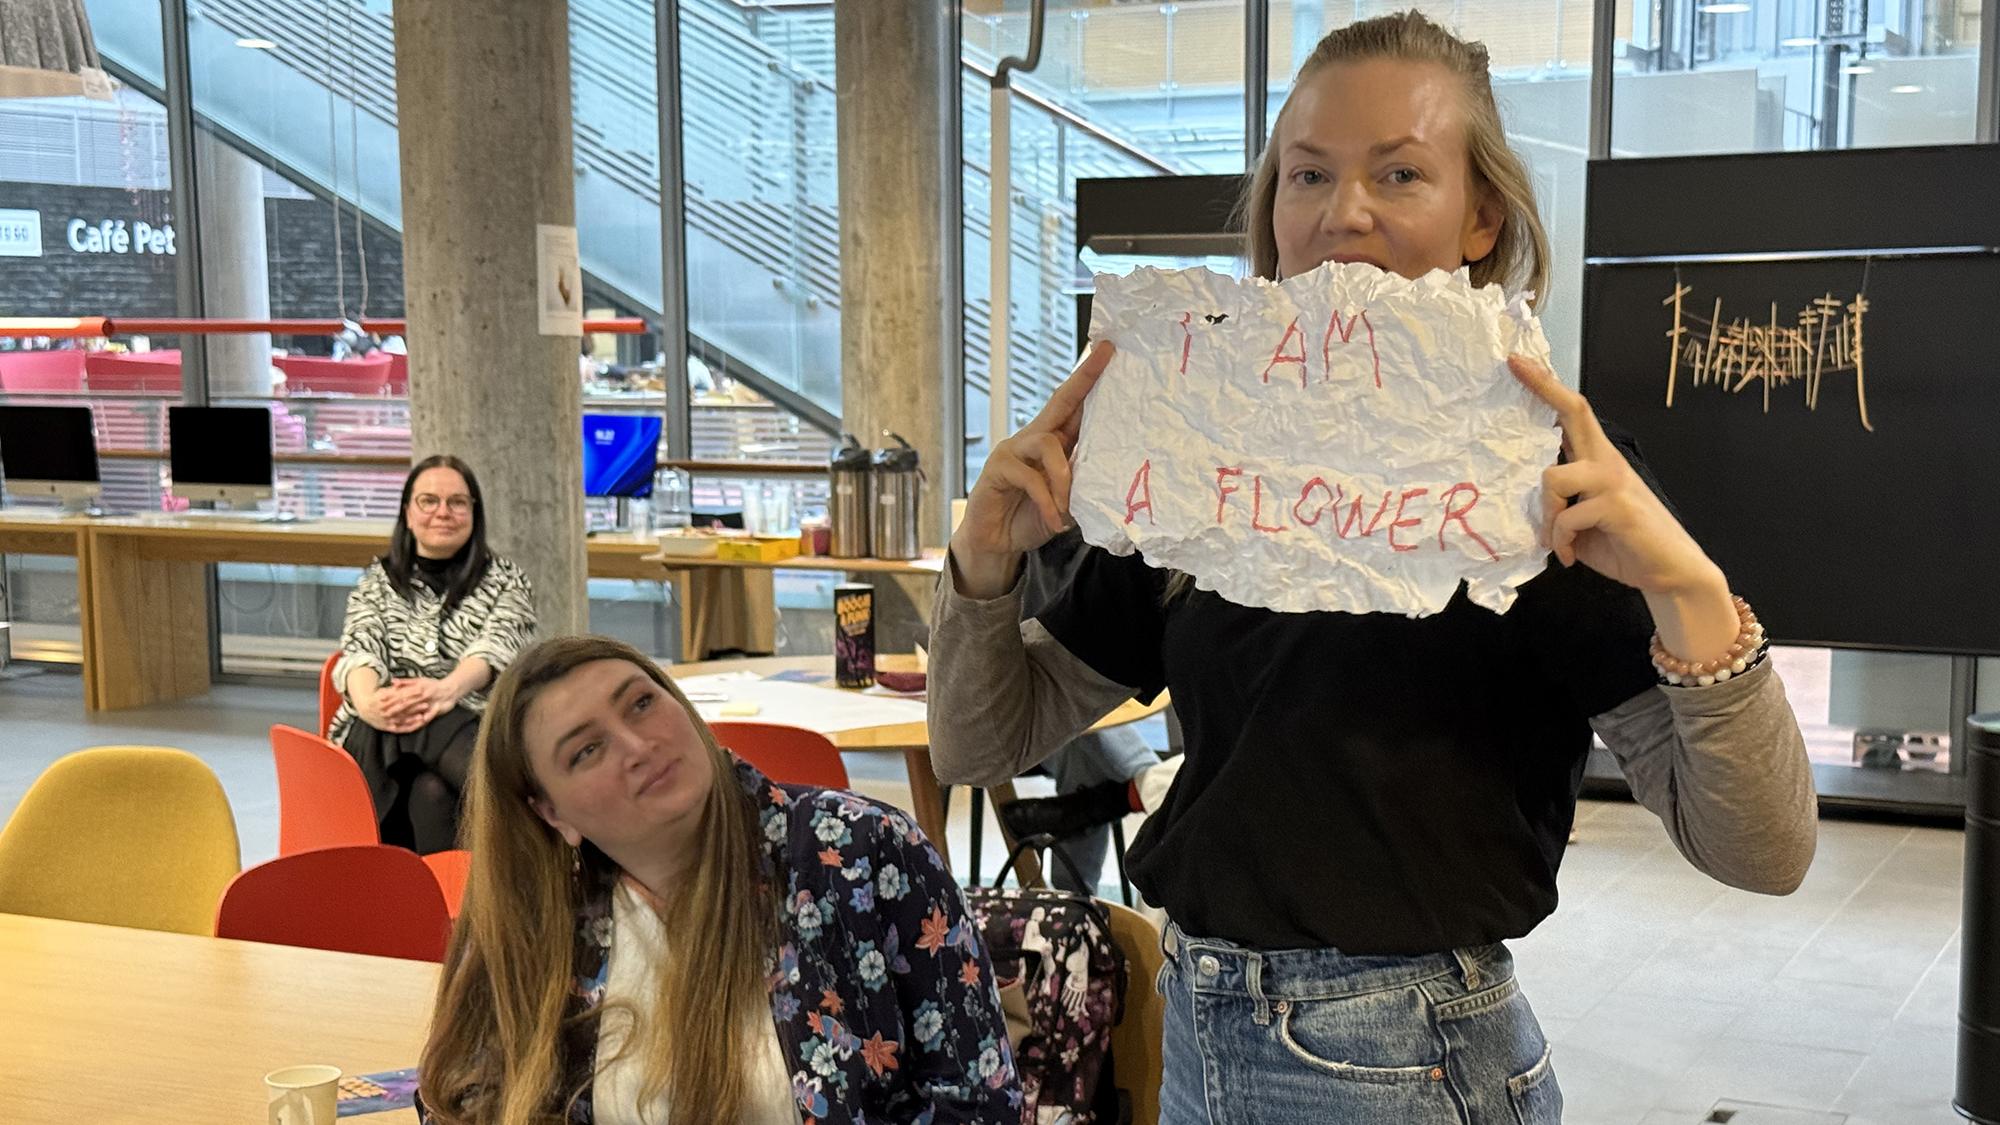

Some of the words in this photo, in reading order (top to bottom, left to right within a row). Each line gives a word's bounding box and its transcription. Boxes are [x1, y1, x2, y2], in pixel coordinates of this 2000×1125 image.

[67, 218, 130, 254] Café
[1179, 312, 1192, 374] I
[1263, 309, 1383, 389] AM
[1123, 459, 1155, 526] A
[1215, 466, 1501, 562] FLOWER
